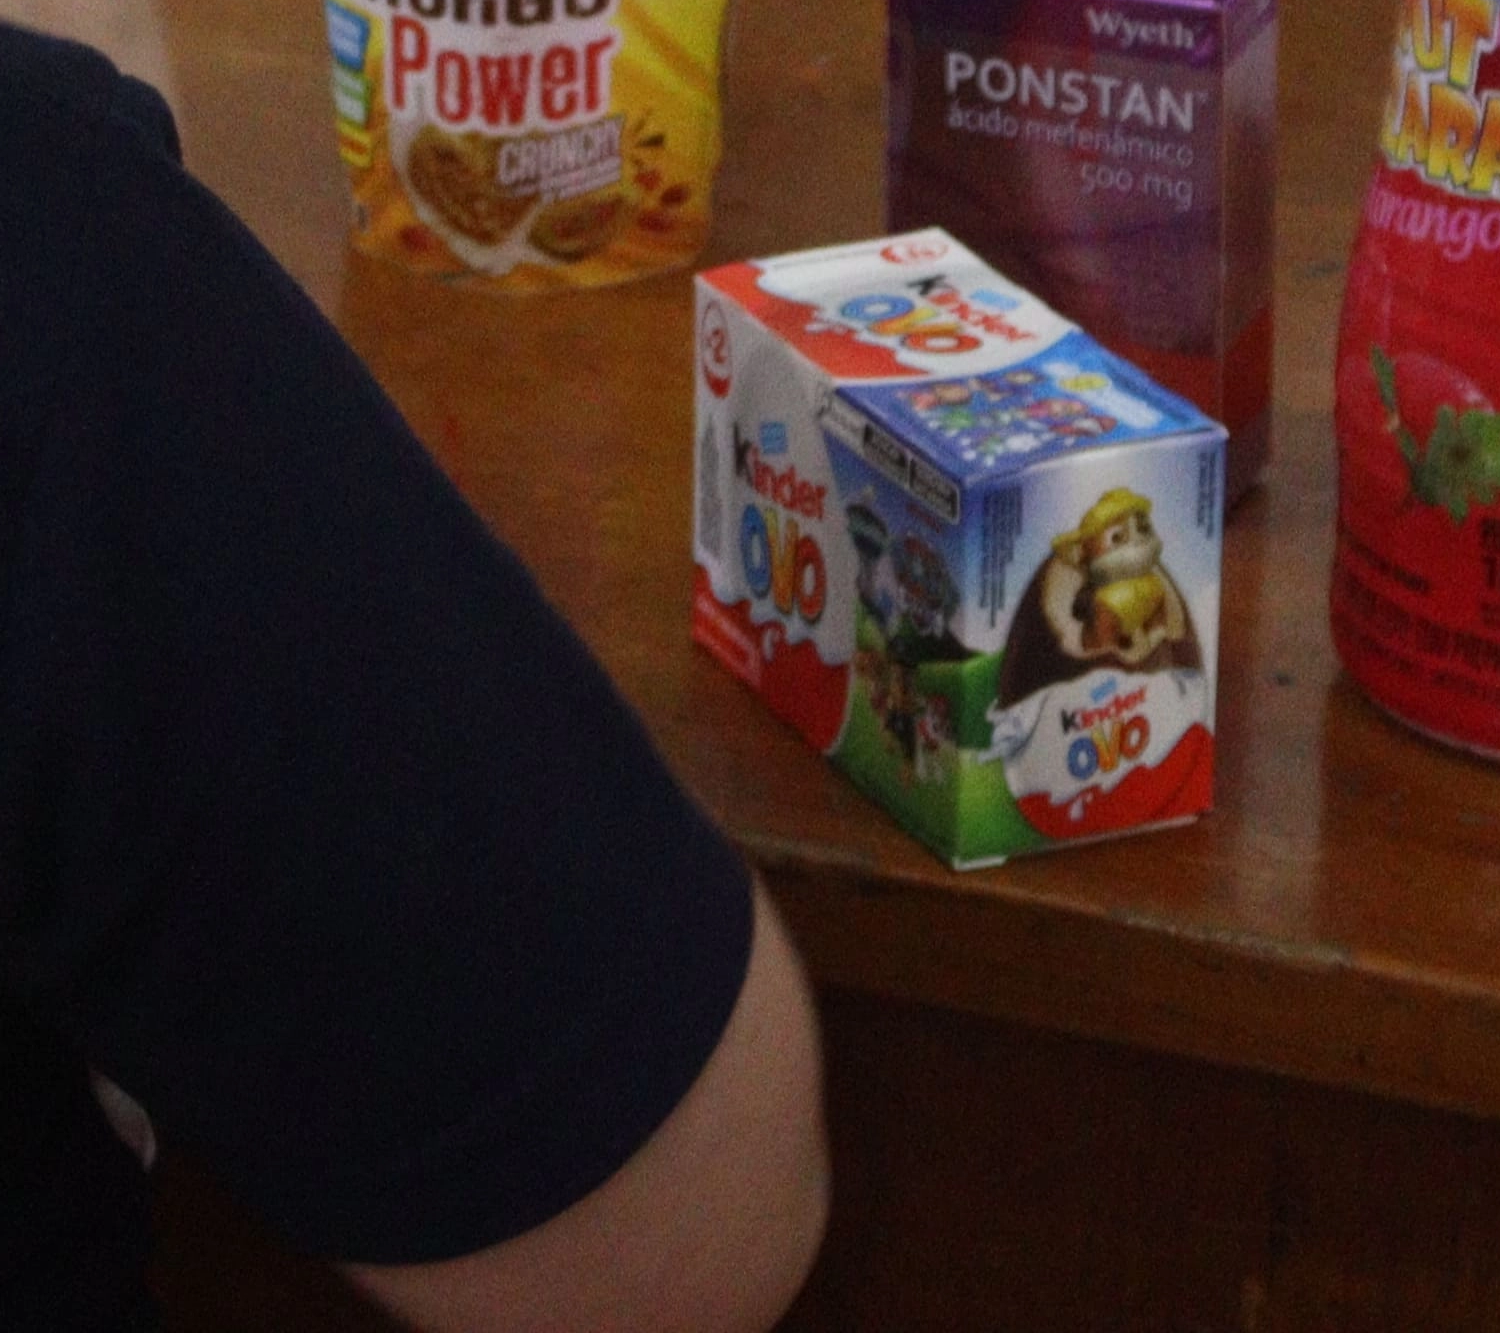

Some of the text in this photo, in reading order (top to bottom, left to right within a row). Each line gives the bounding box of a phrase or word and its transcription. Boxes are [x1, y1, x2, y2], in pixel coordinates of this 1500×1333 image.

[1084, 7, 1196, 51] Wyeth
[391, 13, 614, 125] Power
[944, 51, 1195, 134] PONSTAN
[1079, 161, 1194, 213] 500 mg
[840, 294, 983, 354] OVO
[907, 273, 1039, 343] Kinder
[732, 419, 828, 522] Kinder
[740, 501, 829, 624] OVO
[1060, 684, 1148, 733] Kinder
[1066, 712, 1150, 781] OVO
